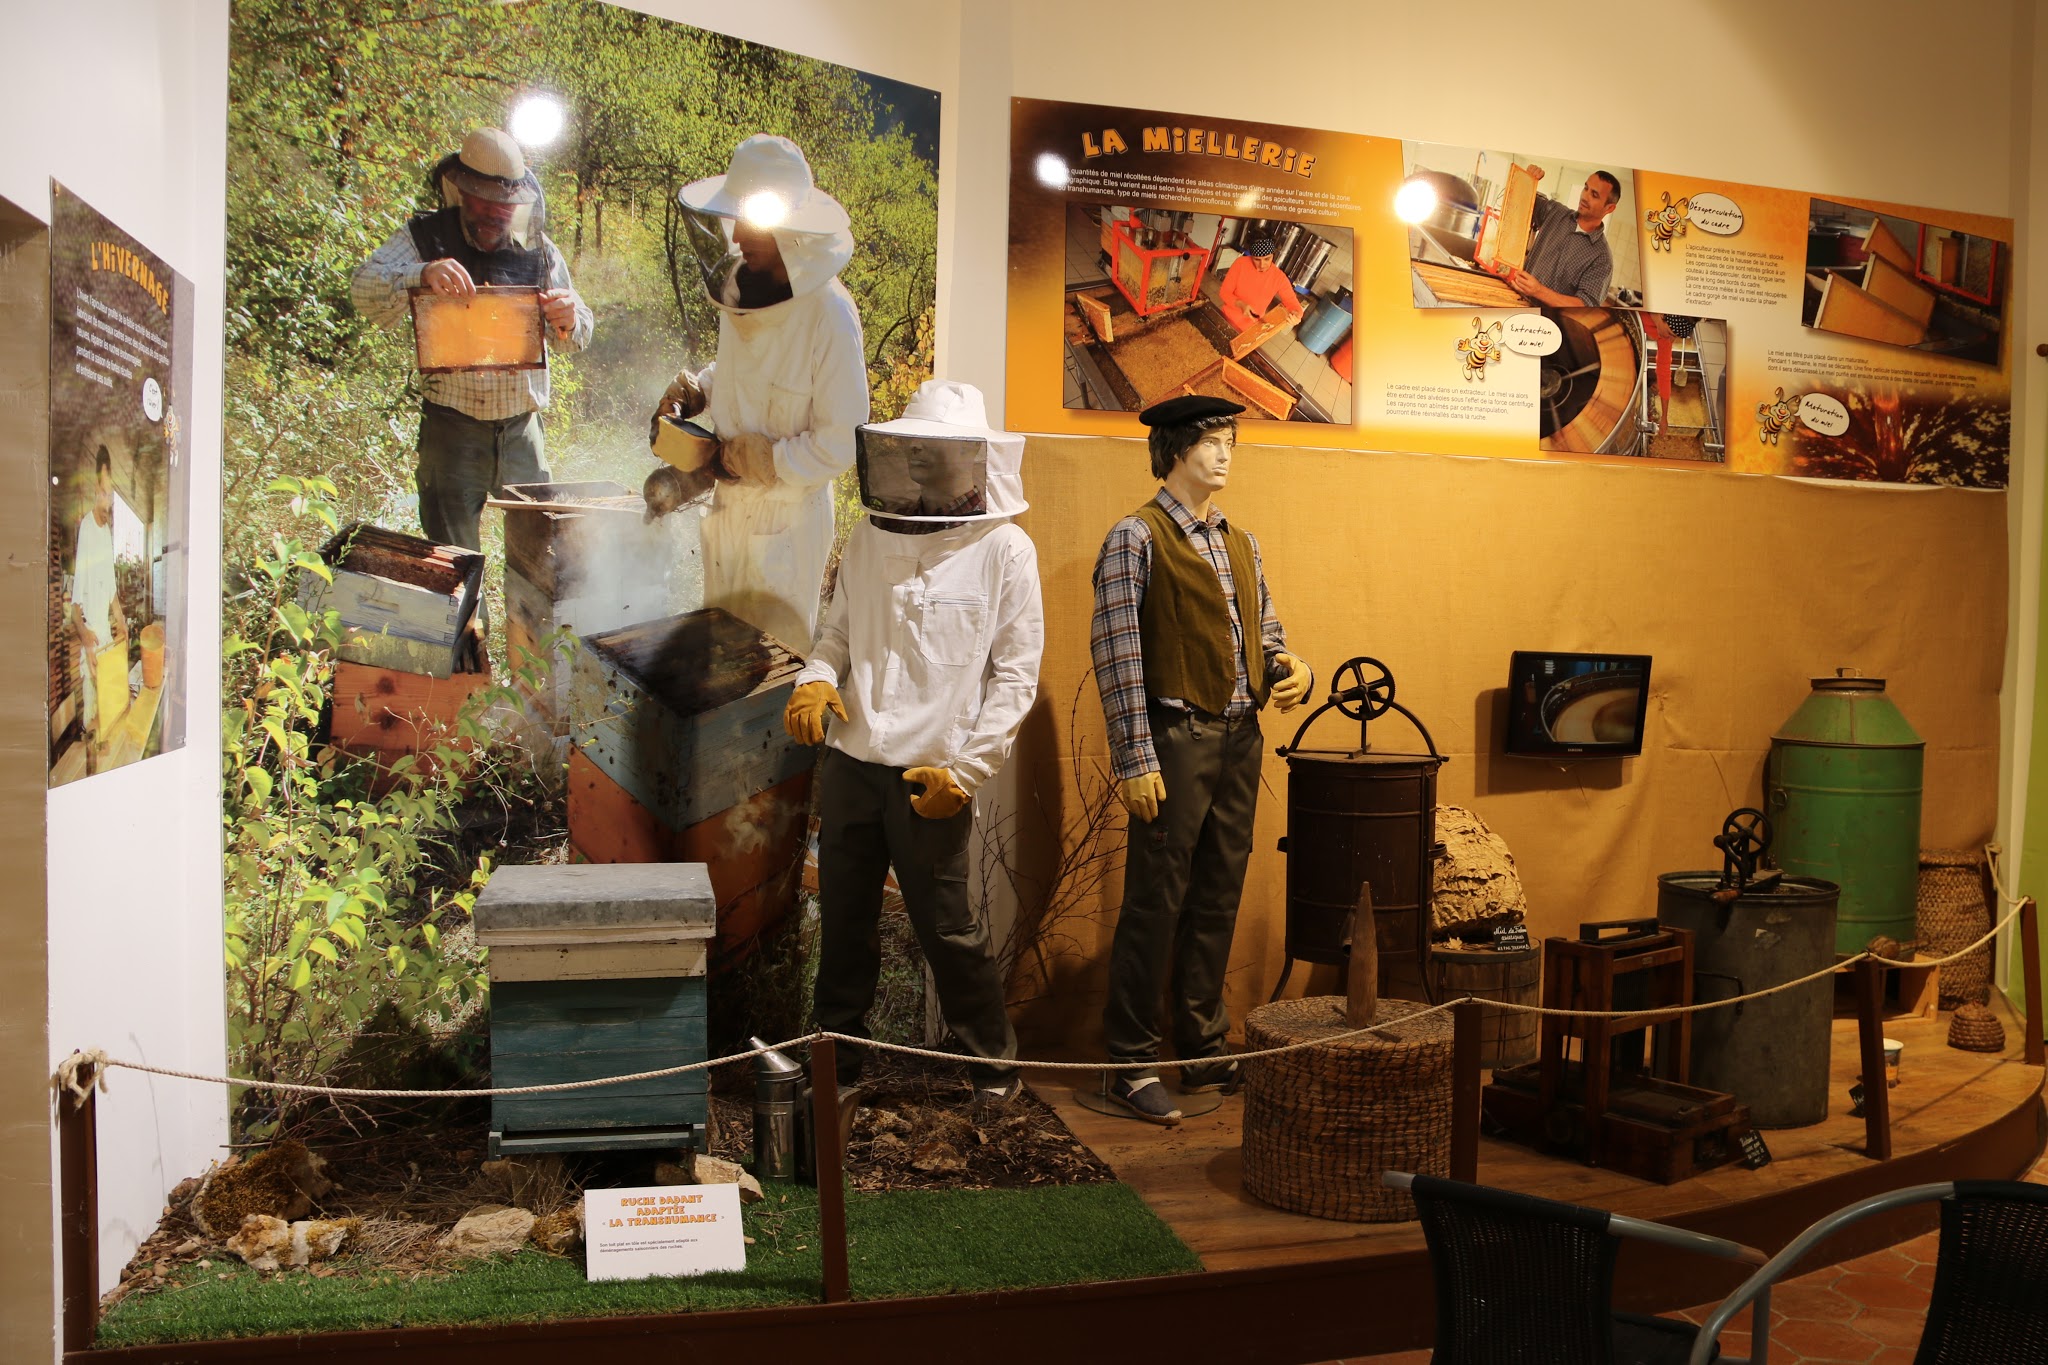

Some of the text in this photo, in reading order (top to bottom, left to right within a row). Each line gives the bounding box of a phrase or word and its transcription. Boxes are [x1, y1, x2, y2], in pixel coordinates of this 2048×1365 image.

[1082, 128, 1128, 158] LA
[1071, 168, 1099, 176] quantités
[1123, 172, 1151, 181] récoltées
[1152, 174, 1184, 184] dépendent
[1198, 179, 1214, 187] aléas
[1215, 181, 1247, 191] climatiques
[1249, 184, 1265, 192] d'une
[1295, 189, 1313, 197] l'autre
[1067, 186, 1116, 196] transhumances,
[1117, 189, 1130, 197] type
[1158, 193, 1192, 202] recherchés
[1297, 207, 1317, 215] grande
[1318, 209, 1340, 217] culture)
[1187, 188, 1214, 197] pratiques
[1273, 197, 1304, 206] apiculteurs
[1689, 201, 1742, 219] Désoperculation
[1711, 221, 1730, 230] cadre
[1510, 323, 1552, 335] Extraction
[1805, 401, 1843, 419] Maturation
[621, 1194, 704, 1207] RUCHE DADANT
[609, 1213, 717, 1228] LA TRANSHUMANCE
